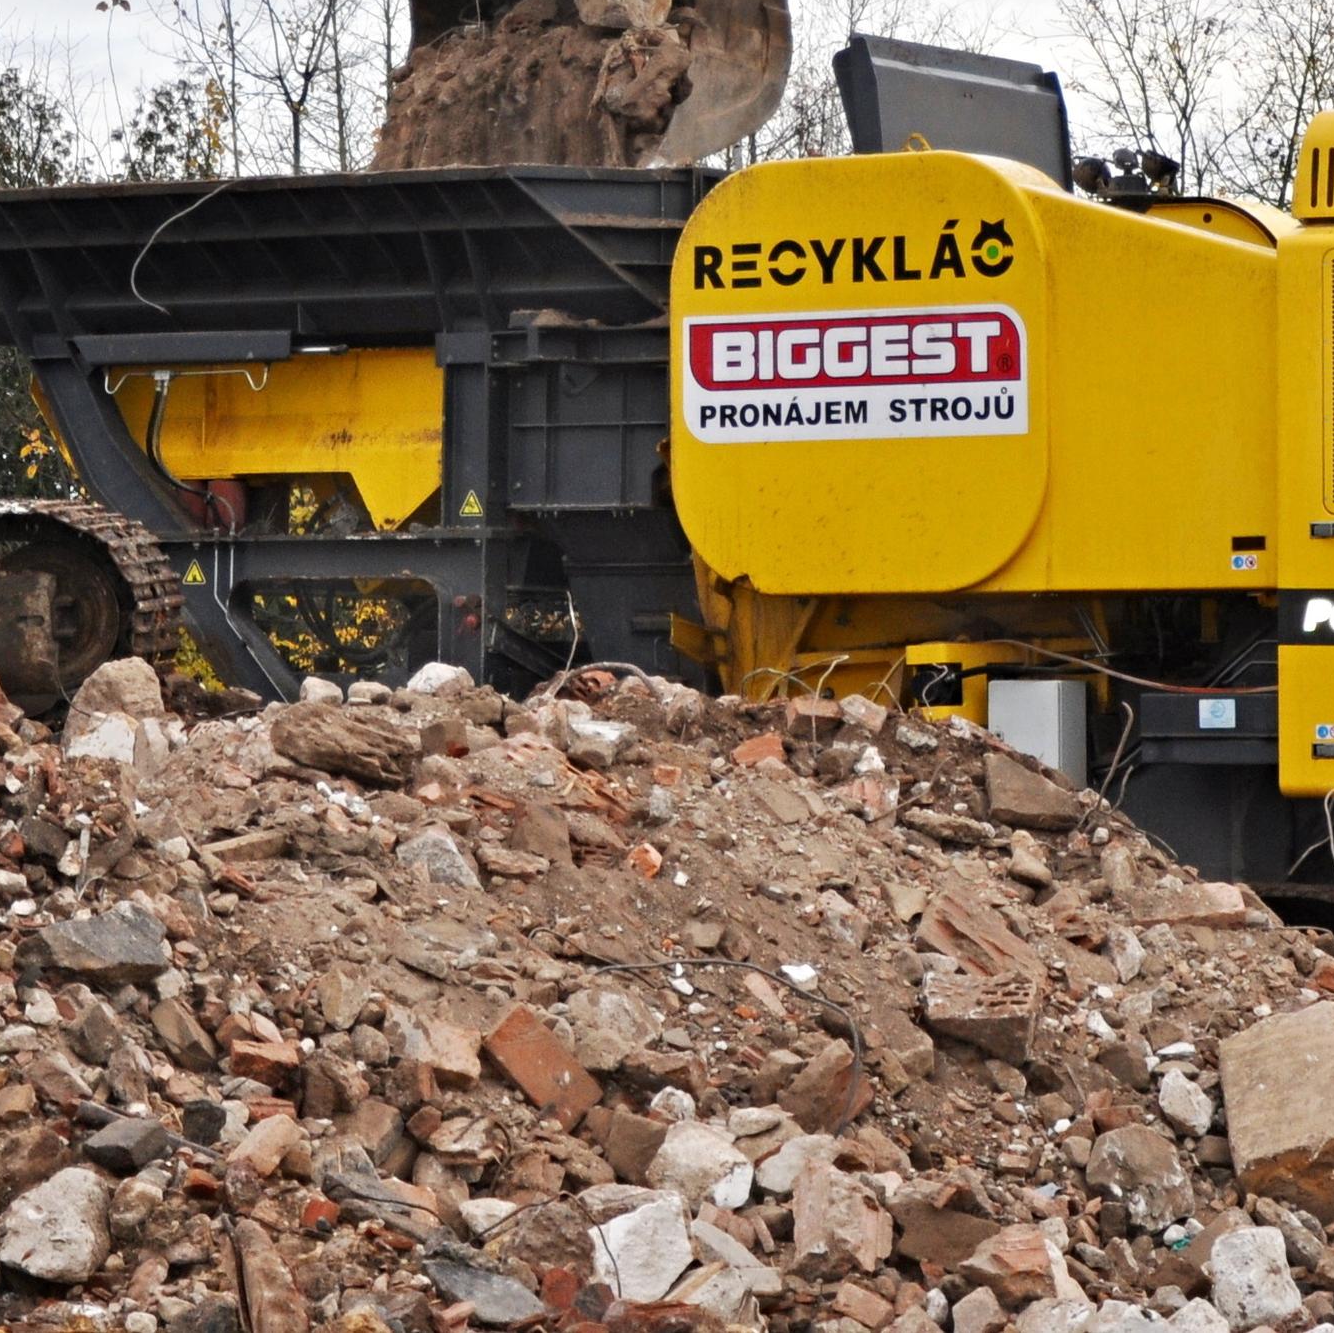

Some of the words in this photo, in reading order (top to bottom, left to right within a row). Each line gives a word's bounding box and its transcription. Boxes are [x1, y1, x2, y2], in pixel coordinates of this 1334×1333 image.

[712, 320, 1002, 382] BIGGEST
[699, 396, 868, 429] PRONÁJEM
[888, 387, 1015, 424] STROJŮ
